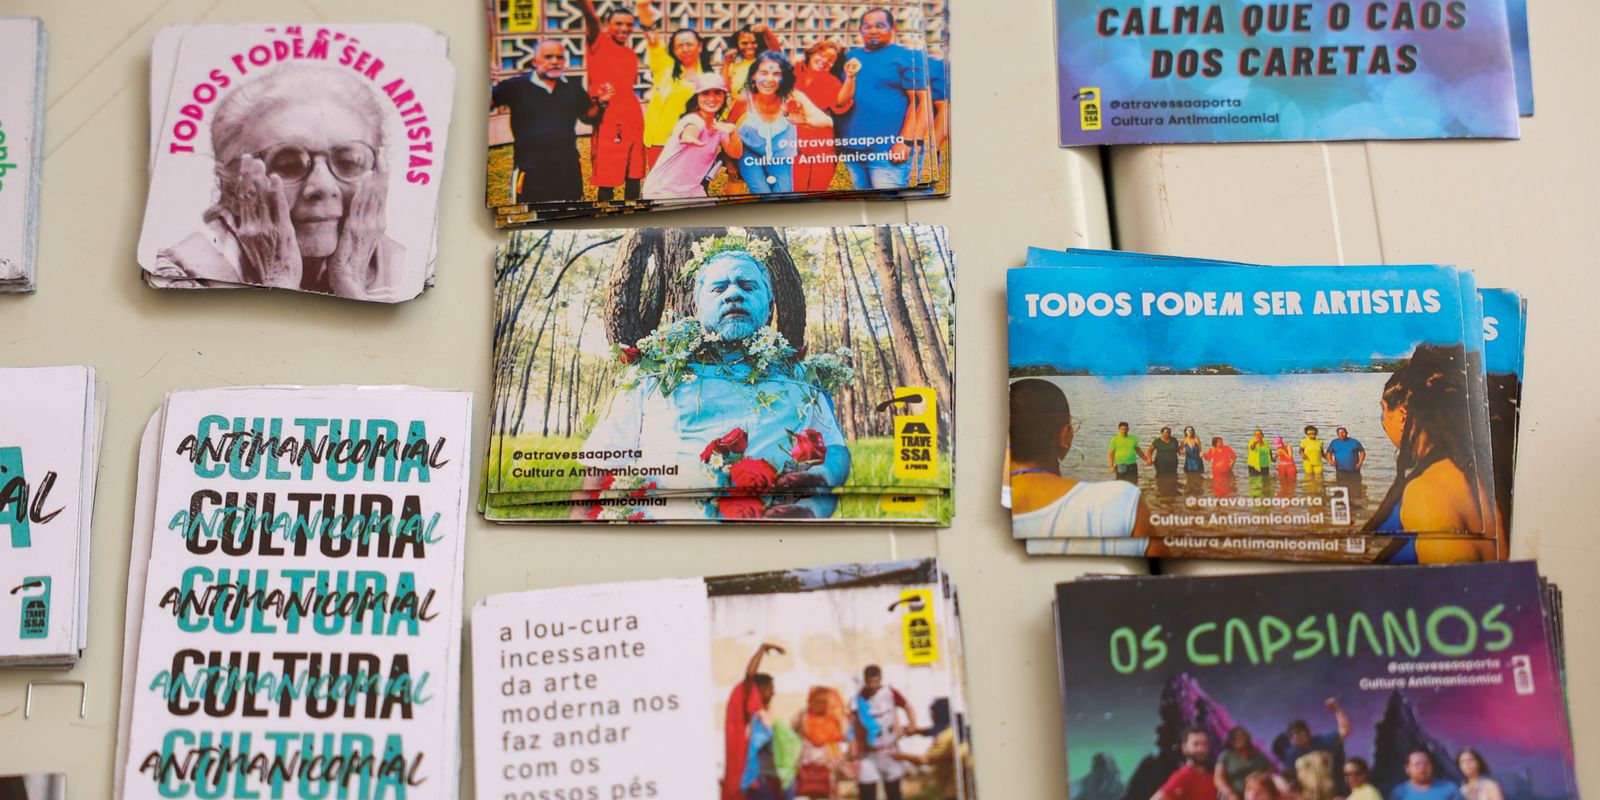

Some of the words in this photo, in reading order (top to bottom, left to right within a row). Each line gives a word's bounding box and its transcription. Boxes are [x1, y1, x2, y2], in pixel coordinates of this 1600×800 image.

[1096, 5, 1225, 37] CALMA
[1240, 4, 1313, 37] QUE
[1327, 2, 1350, 32] O
[1365, 0, 1466, 32] CAOS
[1151, 48, 1225, 79] DOS
[1238, 44, 1418, 78] CARETAS
[169, 69, 231, 154] TODOS
[231, 38, 329, 75] PODEM
[339, 45, 385, 81] SER
[381, 78, 433, 186] ARTISTAS
[1111, 115, 1164, 126] Cultura
[1168, 113, 1279, 126] Antimanicomial
[744, 155, 794, 166] Cultura
[798, 150, 905, 165] Antimanicomial
[1025, 292, 1132, 317] TODOS
[1141, 291, 1243, 316] PODEM
[1253, 291, 1303, 316] SER
[1312, 288, 1441, 315] ARTISTAS
[901, 422, 930, 434] A
[194, 414, 430, 482] CULTURA
[512, 450, 642, 460] @atravessaaporta
[901, 436, 932, 448] TRAVE
[901, 448, 931, 462] SSA
[512, 467, 564, 478] Cultura
[568, 465, 678, 478] Antimanicomial
[1185, 496, 1322, 509] @atravessaaporta
[186, 489, 426, 559] CULTURA
[1150, 514, 1204, 526] Cultura
[1208, 512, 1324, 526] Antimanicomial
[1222, 537, 1339, 552] Antimanicomial
[177, 566, 420, 636] CULTURA
[500, 626, 512, 642] a
[525, 615, 639, 640] lou-cura
[500, 640, 646, 668] incessante
[1110, 624, 1168, 674] OS
[168, 648, 414, 720] CULTURA
[501, 676, 532, 696] da
[544, 672, 598, 692] arte
[502, 700, 620, 724] moderna
[633, 694, 680, 713] nos
[502, 731, 541, 752] faz
[553, 724, 631, 748] andar
[158, 728, 408, 800] CULTURA
[502, 760, 558, 780] com
[570, 757, 600, 774] os
[612, 776, 658, 800] pés
